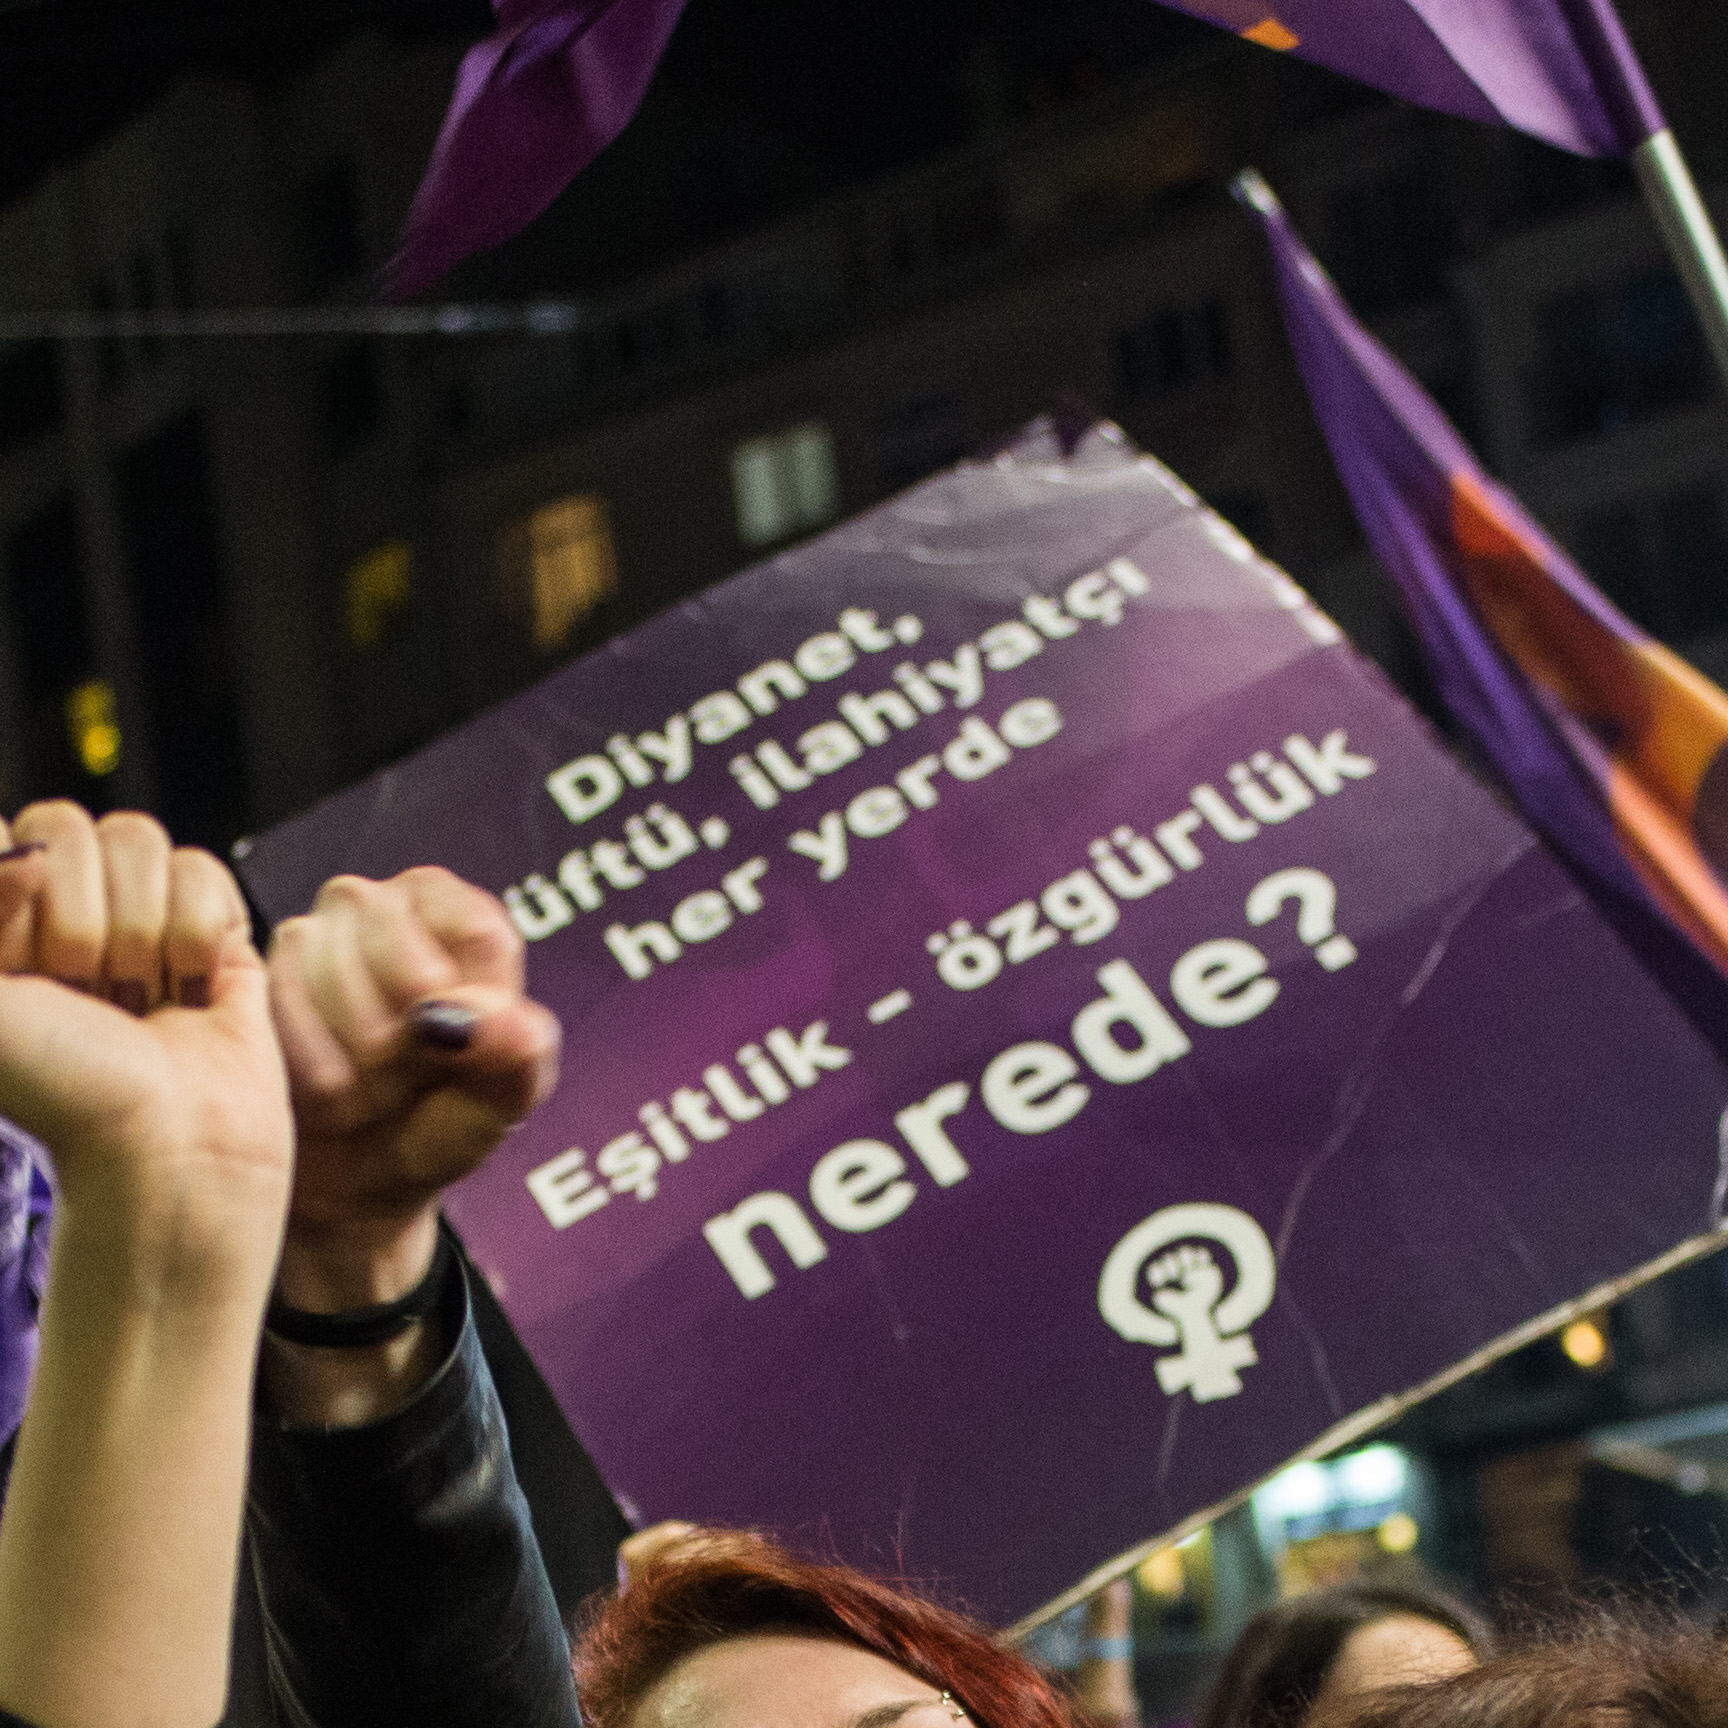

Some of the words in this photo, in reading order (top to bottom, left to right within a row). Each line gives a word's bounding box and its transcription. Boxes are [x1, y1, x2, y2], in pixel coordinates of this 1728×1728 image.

[501, 801, 732, 943] üftü,
[730, 556, 1150, 810] ilahiyatçı
[544, 606, 924, 824] Diyanet,
[603, 854, 770, 982] her
[787, 695, 1064, 883] yerde
[524, 1020, 854, 1231] Eşitlik
[925, 730, 1377, 992] özgürlük
[701, 867, 1359, 1301] nerede?
